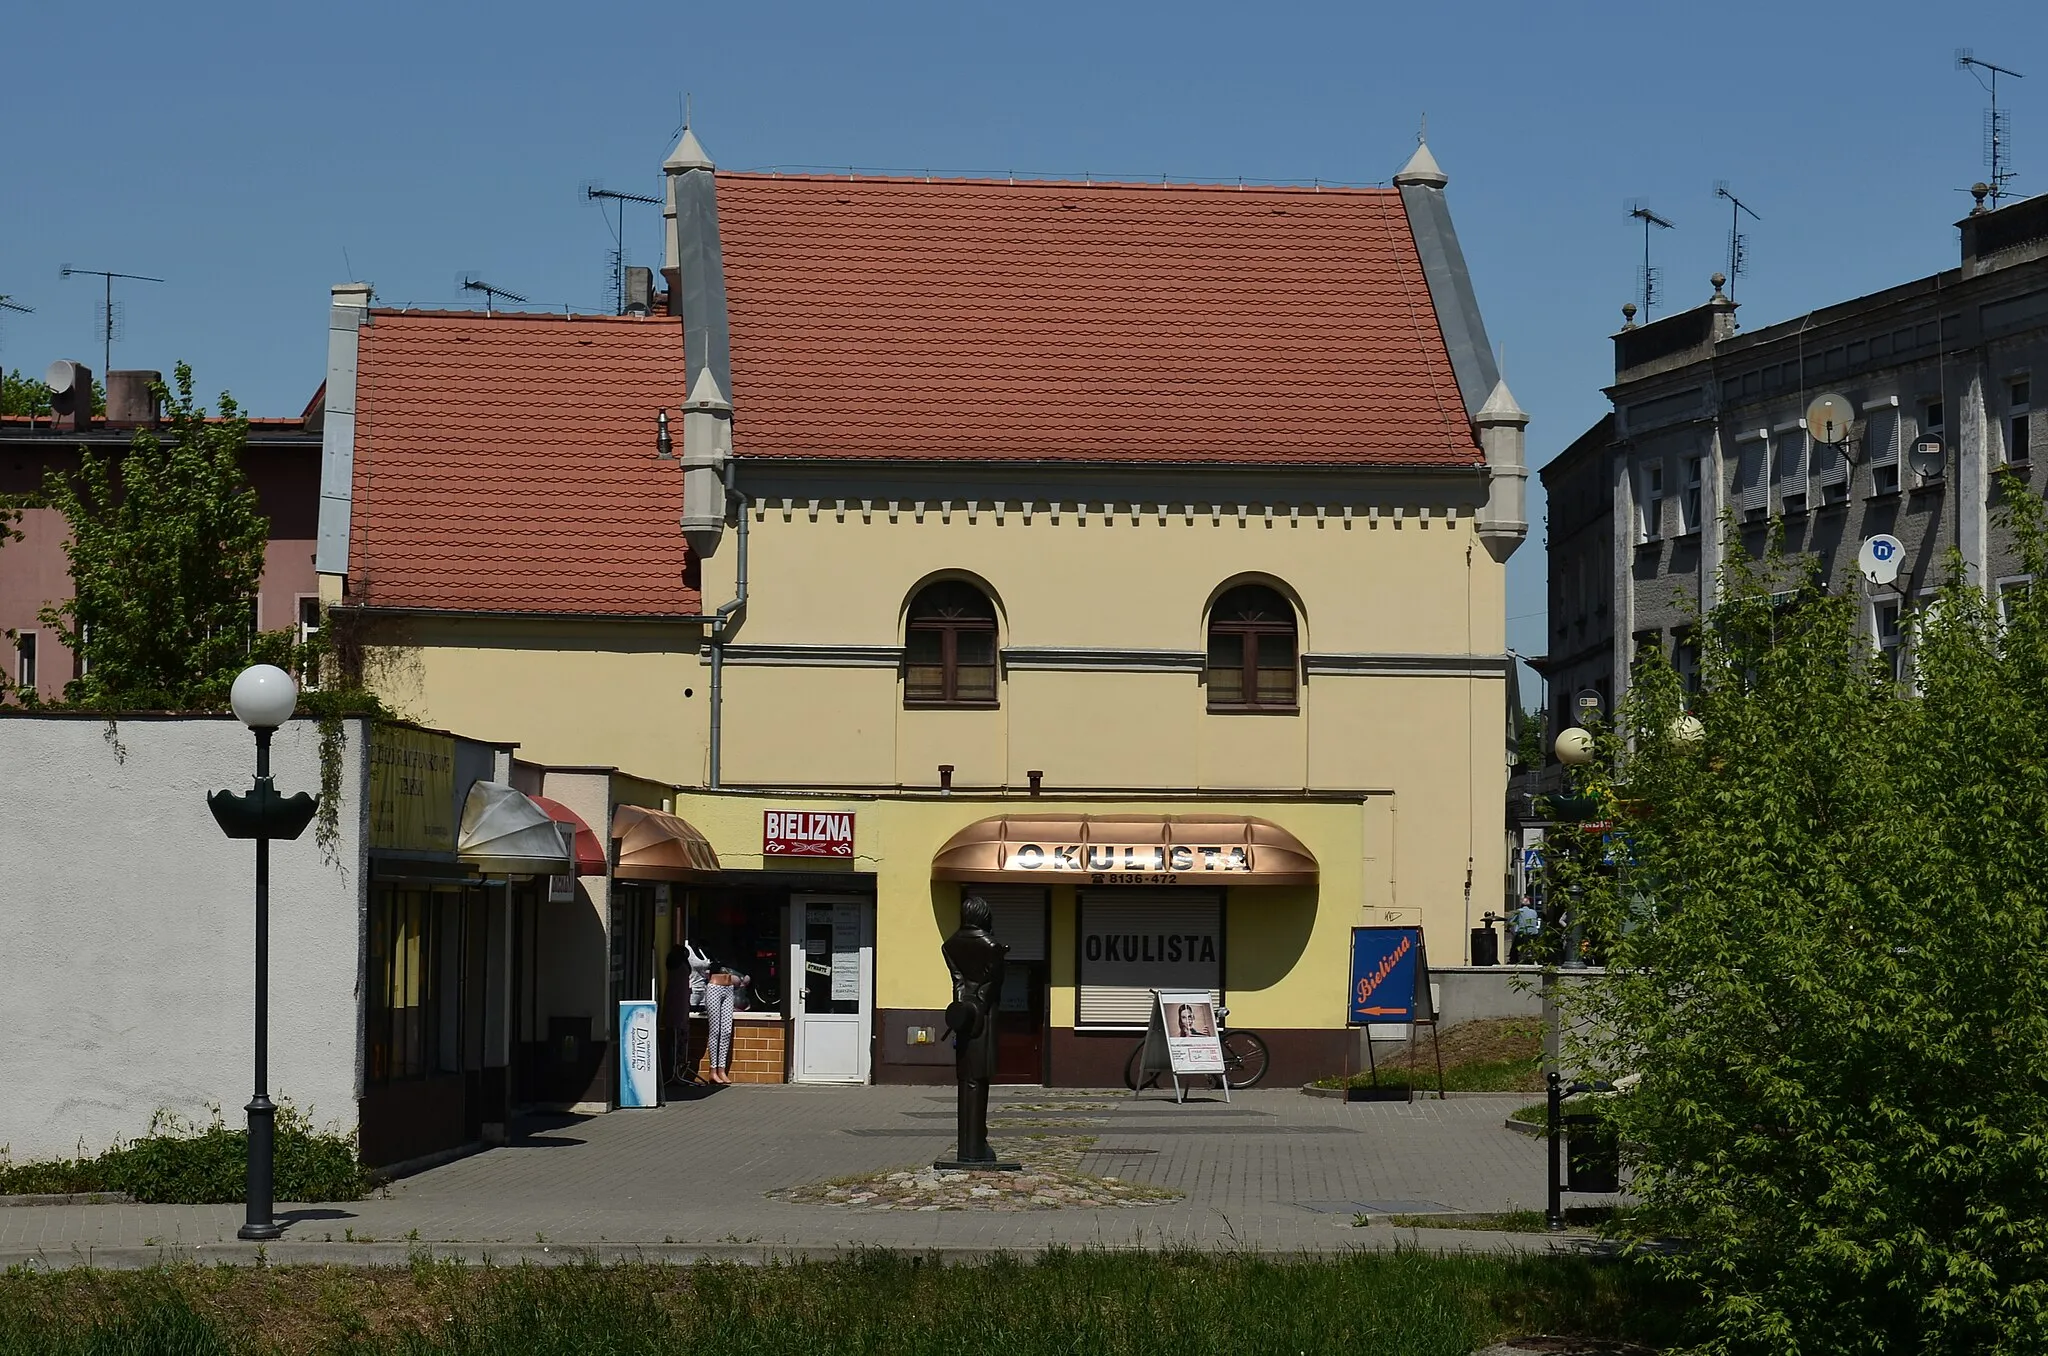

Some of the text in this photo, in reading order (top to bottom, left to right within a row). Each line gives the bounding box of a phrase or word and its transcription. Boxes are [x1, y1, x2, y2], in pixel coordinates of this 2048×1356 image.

[766, 813, 853, 842] BIELIZNA
[1017, 844, 1252, 871] OKULISTA
[1109, 874, 1177, 884] 8136-472
[1086, 934, 1216, 963] OKULISTA
[1357, 936, 1411, 1004] Bielizna
[637, 1028, 649, 1071] DAILIES
